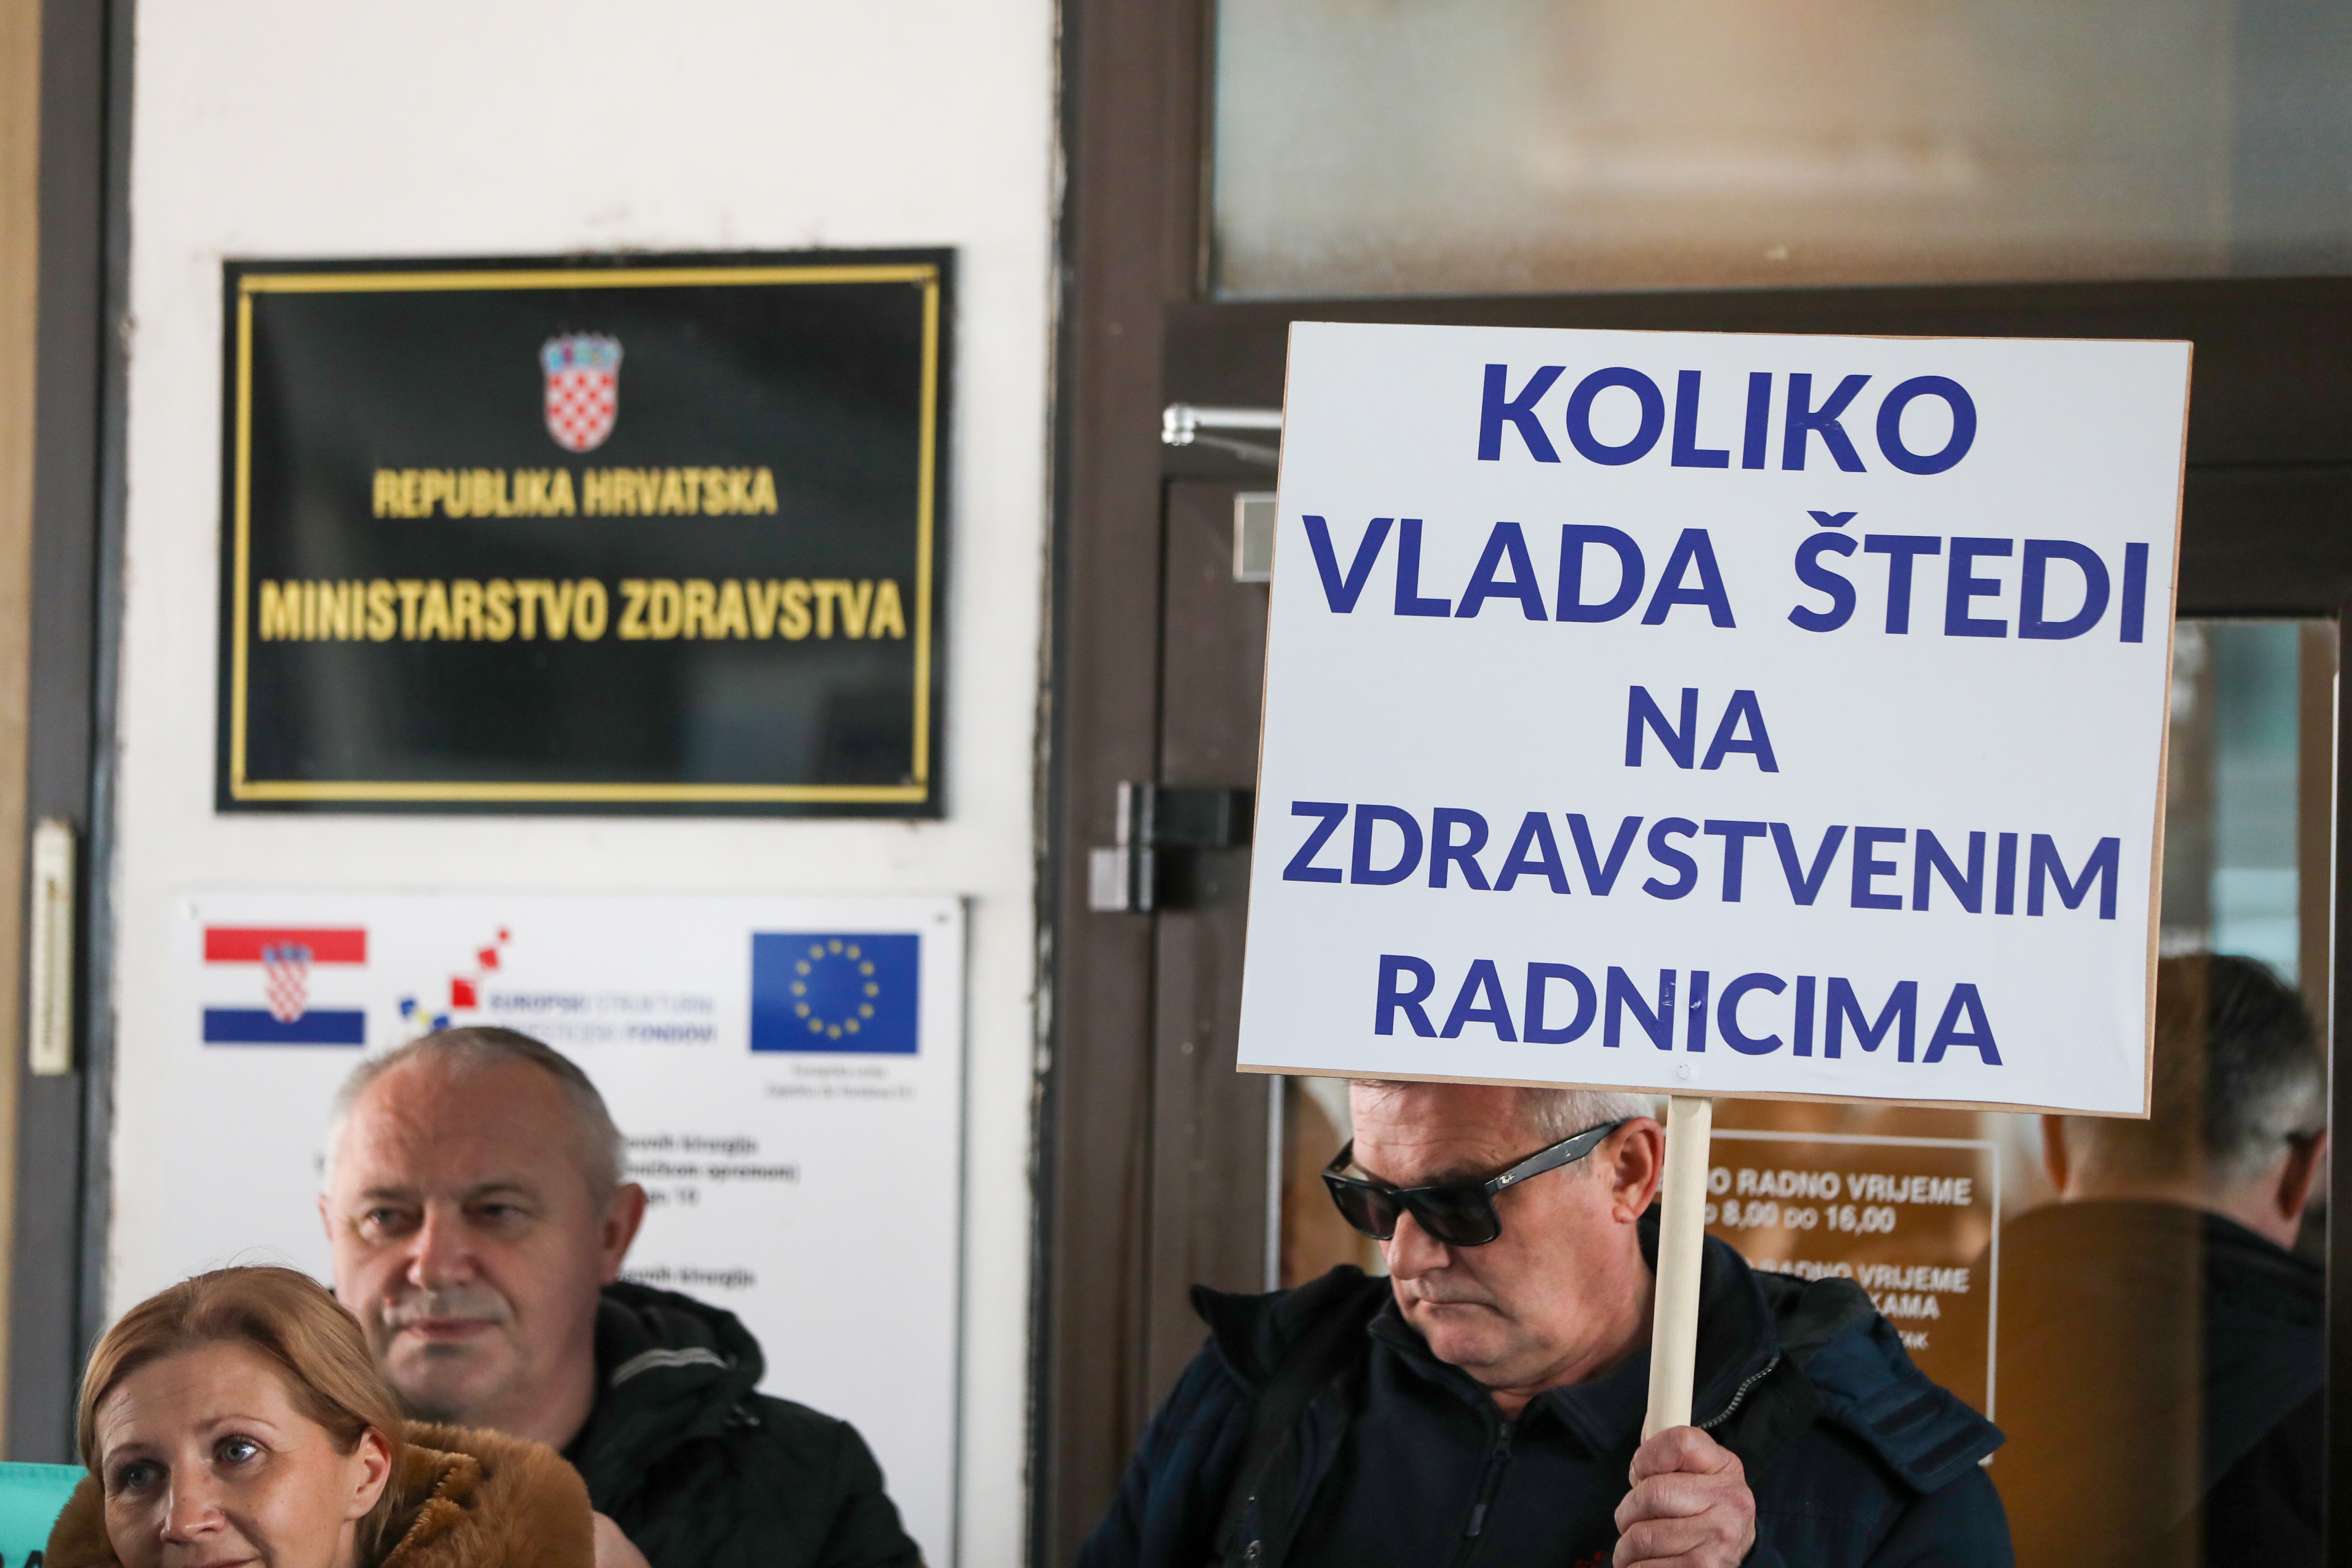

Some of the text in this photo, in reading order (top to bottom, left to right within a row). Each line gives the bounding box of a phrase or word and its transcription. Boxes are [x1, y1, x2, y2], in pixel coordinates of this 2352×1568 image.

[1478, 363, 1977, 475] KOLIKO
[372, 467, 778, 518] REPUBLIKA HRVATSKA
[259, 578, 905, 642] MINISTARSTVO ZDRAVSTVA
[1302, 510, 2149, 643] VLADA ŠTEDI
[1625, 685, 1779, 772] NA
[1283, 800, 2121, 920] ZDRAVSTVENIM
[1375, 954, 2003, 1066] RADNICIMA
[1721, 1199, 1780, 1231] 8,00
[1783, 1206, 1819, 1231] DO
[1825, 1204, 1897, 1236] 16,00
[1736, 1168, 1841, 1200] RADNO
[1847, 1173, 1972, 1206] VRIJEME
[1856, 1263, 1971, 1294] VRIJEME
